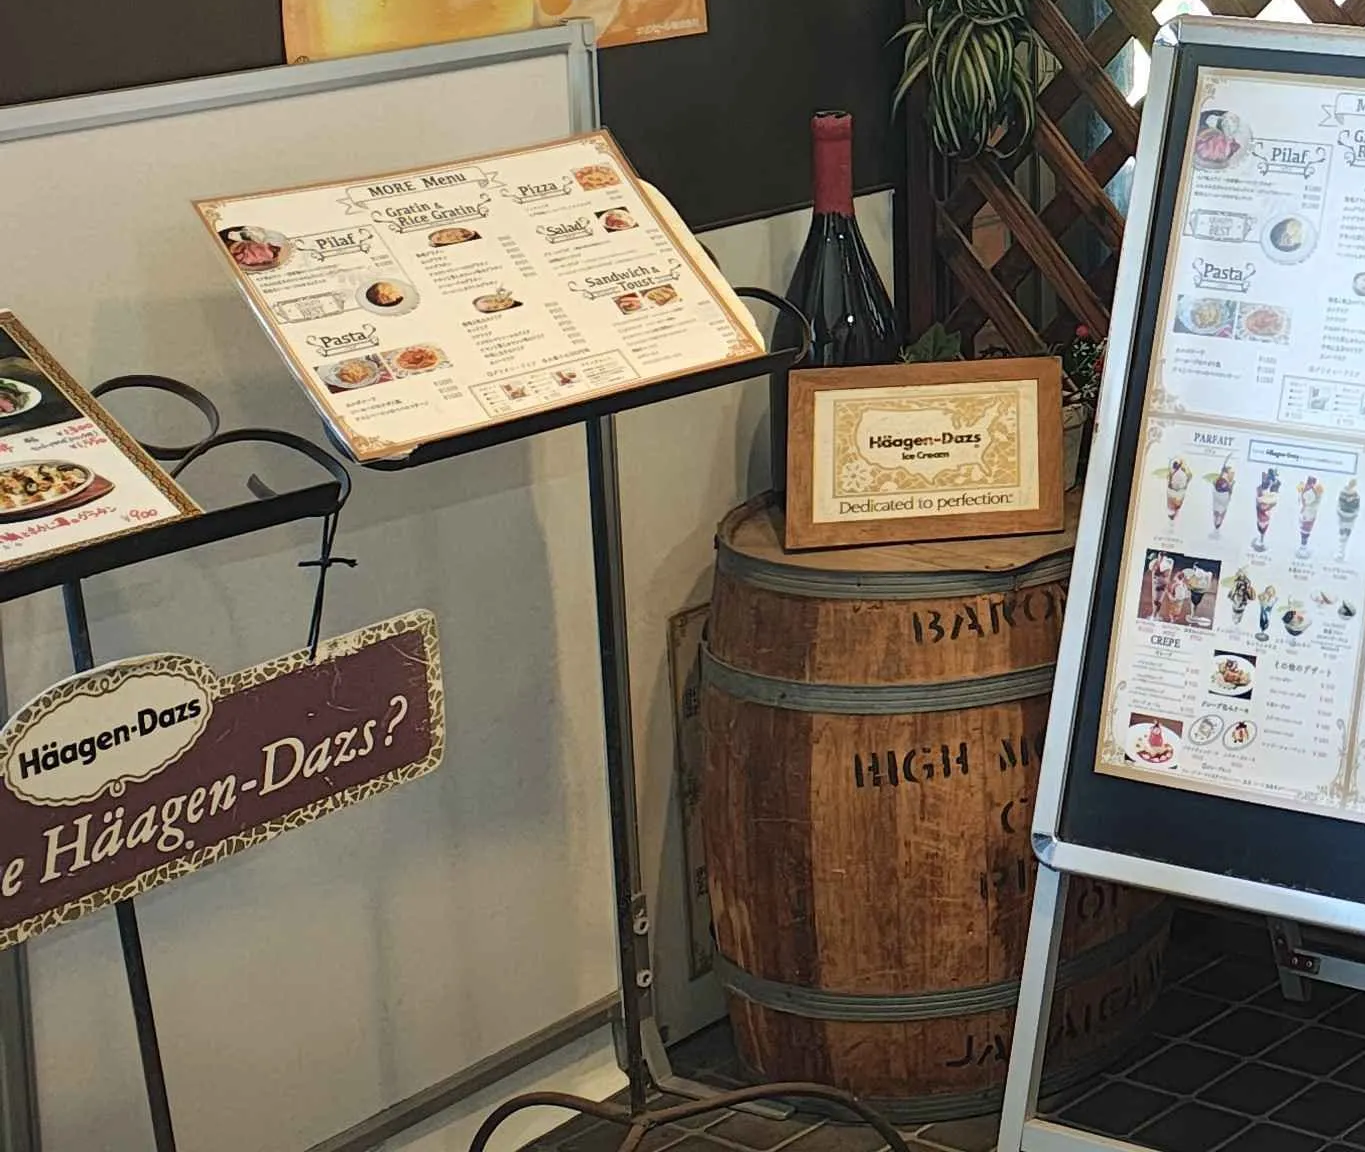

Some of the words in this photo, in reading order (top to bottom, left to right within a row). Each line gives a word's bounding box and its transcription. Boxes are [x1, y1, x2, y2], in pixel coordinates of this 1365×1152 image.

[1270, 147, 1310, 165] Pilaf
[367, 179, 414, 199] MORE
[421, 172, 466, 190] Menu
[518, 181, 557, 197] Pizza
[385, 200, 431, 219] Gratin
[433, 200, 443, 210] &
[399, 212, 430, 229] Rice
[431, 204, 476, 224] Gratin
[546, 220, 583, 237] Salad
[315, 233, 356, 251] Pilaf
[584, 266, 649, 288] Sandwich
[651, 265, 660, 275] &
[1203, 263, 1244, 282] Pasta
[619, 276, 656, 293] Toust
[320, 330, 367, 349] Pasta
[868, 430, 982, 450] Häagen-Dazs
[1193, 432, 1235, 447] PARFAIT
[901, 452, 915, 461] Ice
[917, 450, 950, 460] Cream
[839, 496, 914, 515] Dedicated
[918, 496, 933, 510] to
[910, 584, 1066, 645] BARO
[1150, 634, 1181, 649] CREPE
[1275, 660, 1333, 677] その他のデザート
[18, 697, 202, 780] Häagen-Dazs
[854, 742, 970, 788] HIGH
[39, 695, 409, 885] Häagen-Dazs?
